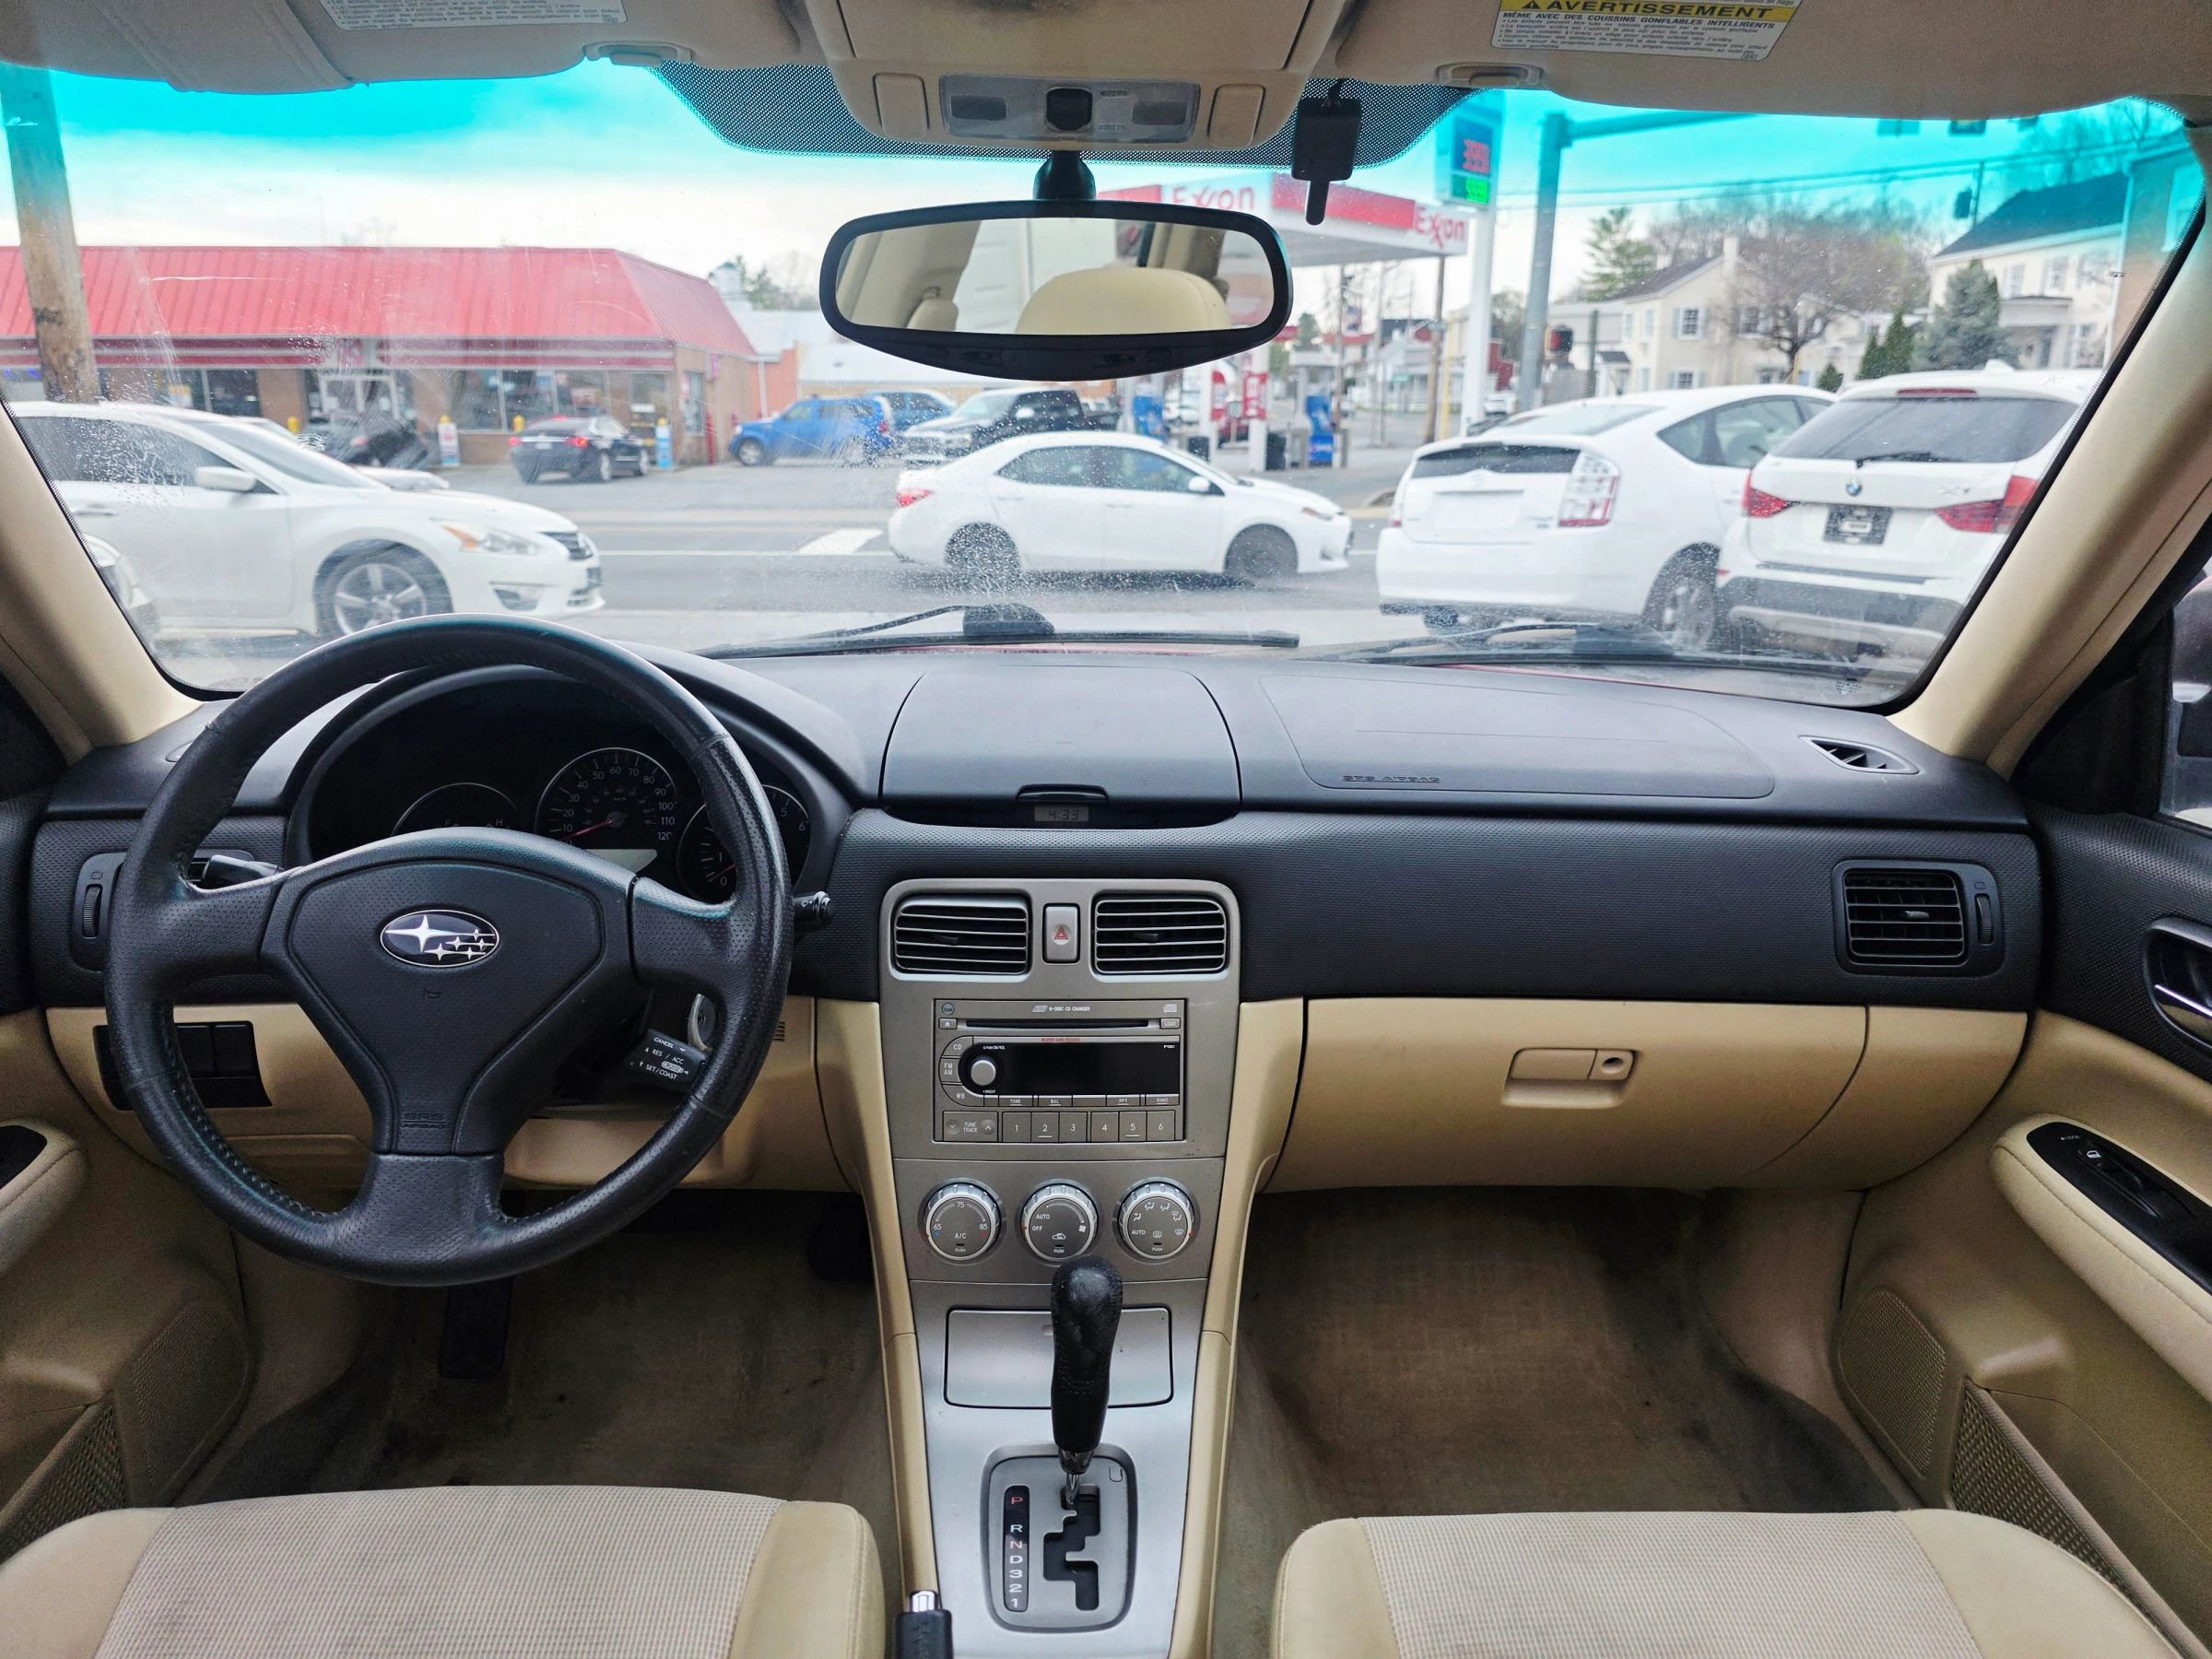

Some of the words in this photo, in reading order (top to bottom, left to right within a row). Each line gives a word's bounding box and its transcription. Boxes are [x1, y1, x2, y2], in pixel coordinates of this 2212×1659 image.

[1547, 0, 1774, 18] AVERTISSEMENT
[1587, 14, 1637, 23] COUSSINS
[1641, 18, 1703, 26] GONFLABLES
[1708, 19, 1776, 29] INTELLIGENTS
[1172, 185, 1254, 210] Exxon
[1416, 206, 1465, 251] Exxon
[593, 771, 605, 780] 50
[628, 768, 640, 776] 70
[577, 781, 589, 789] 40
[654, 788, 666, 796] 90
[568, 794, 580, 803] 30
[658, 802, 674, 810] 100
[562, 808, 574, 818] 20
[782, 807, 788, 818] 5
[1048, 809, 1078, 820] 4:33
[496, 818, 503, 827] H
[661, 817, 676, 825] 110
[798, 820, 806, 831] 6
[563, 823, 573, 832] 10
[657, 831, 672, 841] 120
[720, 876, 727, 886] 0
[653, 1037, 675, 1049] CANCEL
[652, 1048, 663, 1057] RES
[672, 1056, 685, 1065] ACC
[1042, 1124, 1048, 1132] 2
[1070, 1124, 1076, 1132] 3
[1101, 1124, 1107, 1132] 4
[1130, 1123, 1135, 1131] 5
[954, 1231, 967, 1240] A/C
[1011, 1496, 1023, 1504] P
[1010, 1524, 1023, 1533] R
[1010, 1540, 1023, 1549] N
[1009, 1556, 1023, 1564] D
[1009, 1570, 1023, 1579] 3
[1008, 1584, 1023, 1593] 2
[1011, 1598, 1018, 1607] 1
